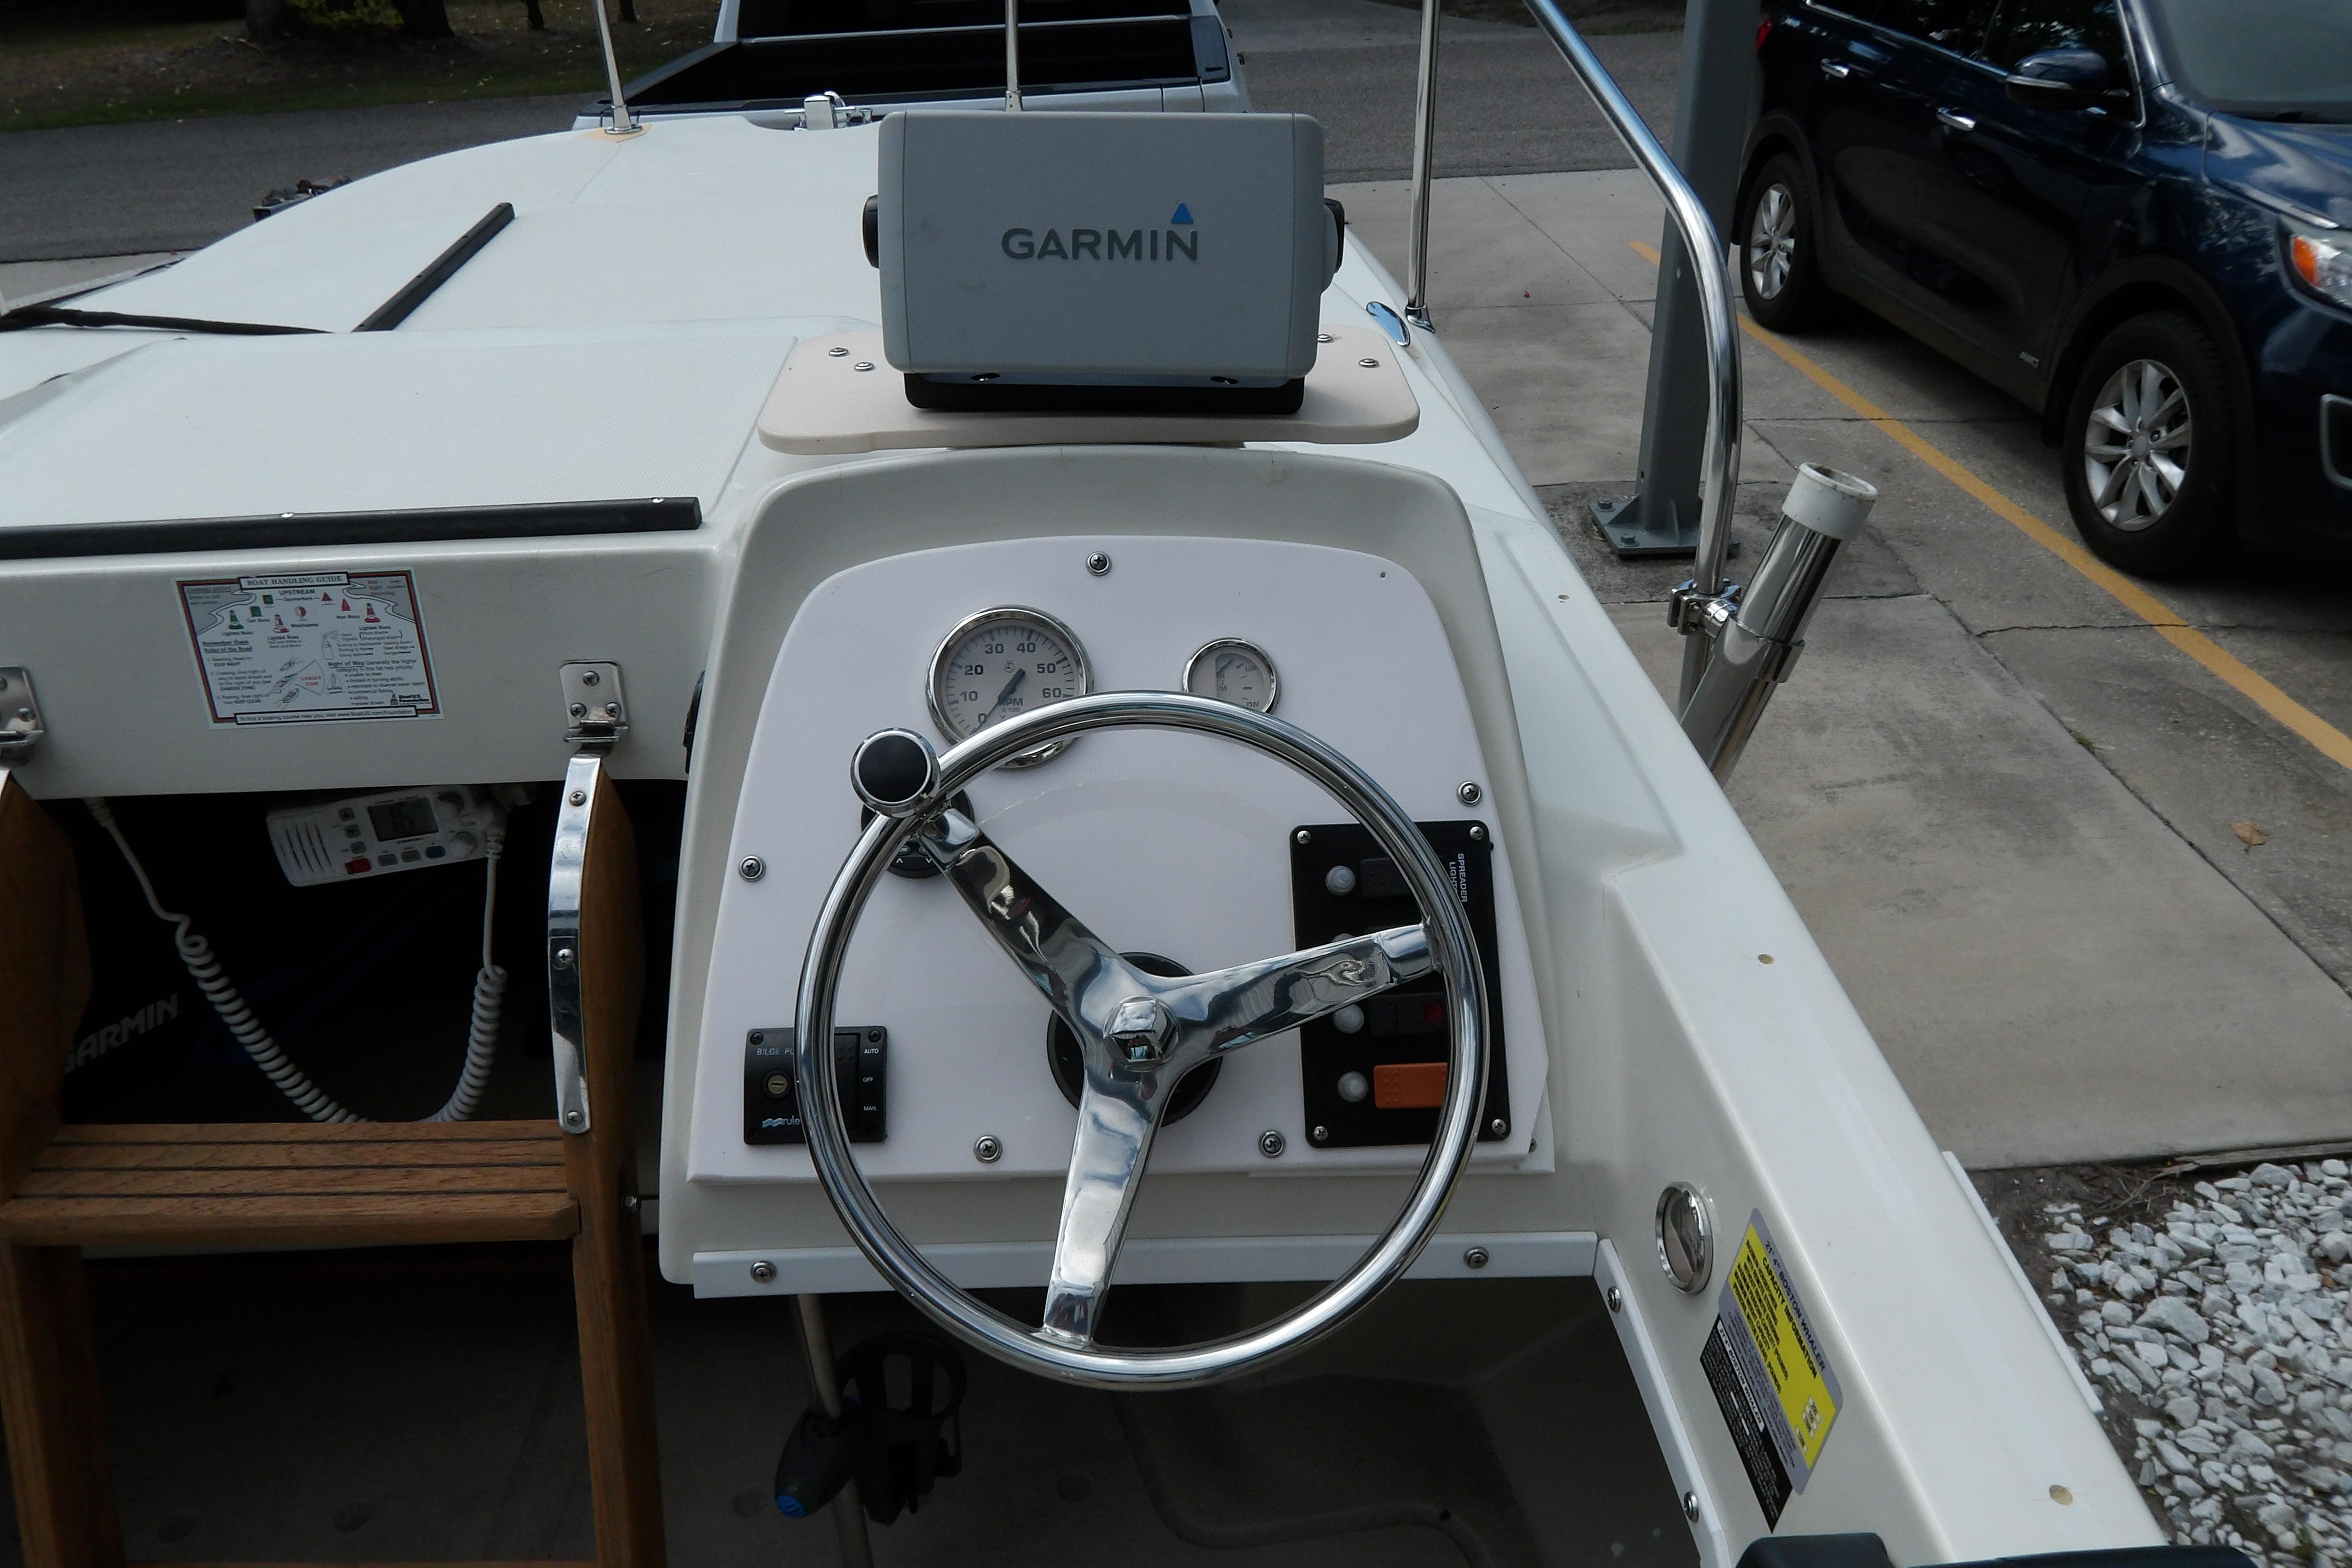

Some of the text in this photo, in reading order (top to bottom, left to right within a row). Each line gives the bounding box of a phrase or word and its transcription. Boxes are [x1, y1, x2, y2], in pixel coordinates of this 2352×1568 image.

[1001, 227, 1198, 261] GARMIN
[984, 643, 1004, 654] 30
[1016, 642, 1036, 653] 40
[964, 664, 984, 676] 20
[1036, 663, 1056, 674] 50
[960, 691, 978, 702] 10
[1042, 687, 1062, 698] 60
[977, 713, 987, 724] 0
[1457, 853, 1468, 903] SPREADER
[756, 1048, 780, 1056] BILGE
[1762, 1257, 1785, 1306] CAPACITY
[1784, 1305, 1818, 1377] INFORMATION
[1778, 1271, 1801, 1318] BOSTON
[1801, 1319, 1826, 1372] WHALER
[1730, 1349, 1744, 1385] BOSTON
[1744, 1384, 1761, 1425] WHALER
